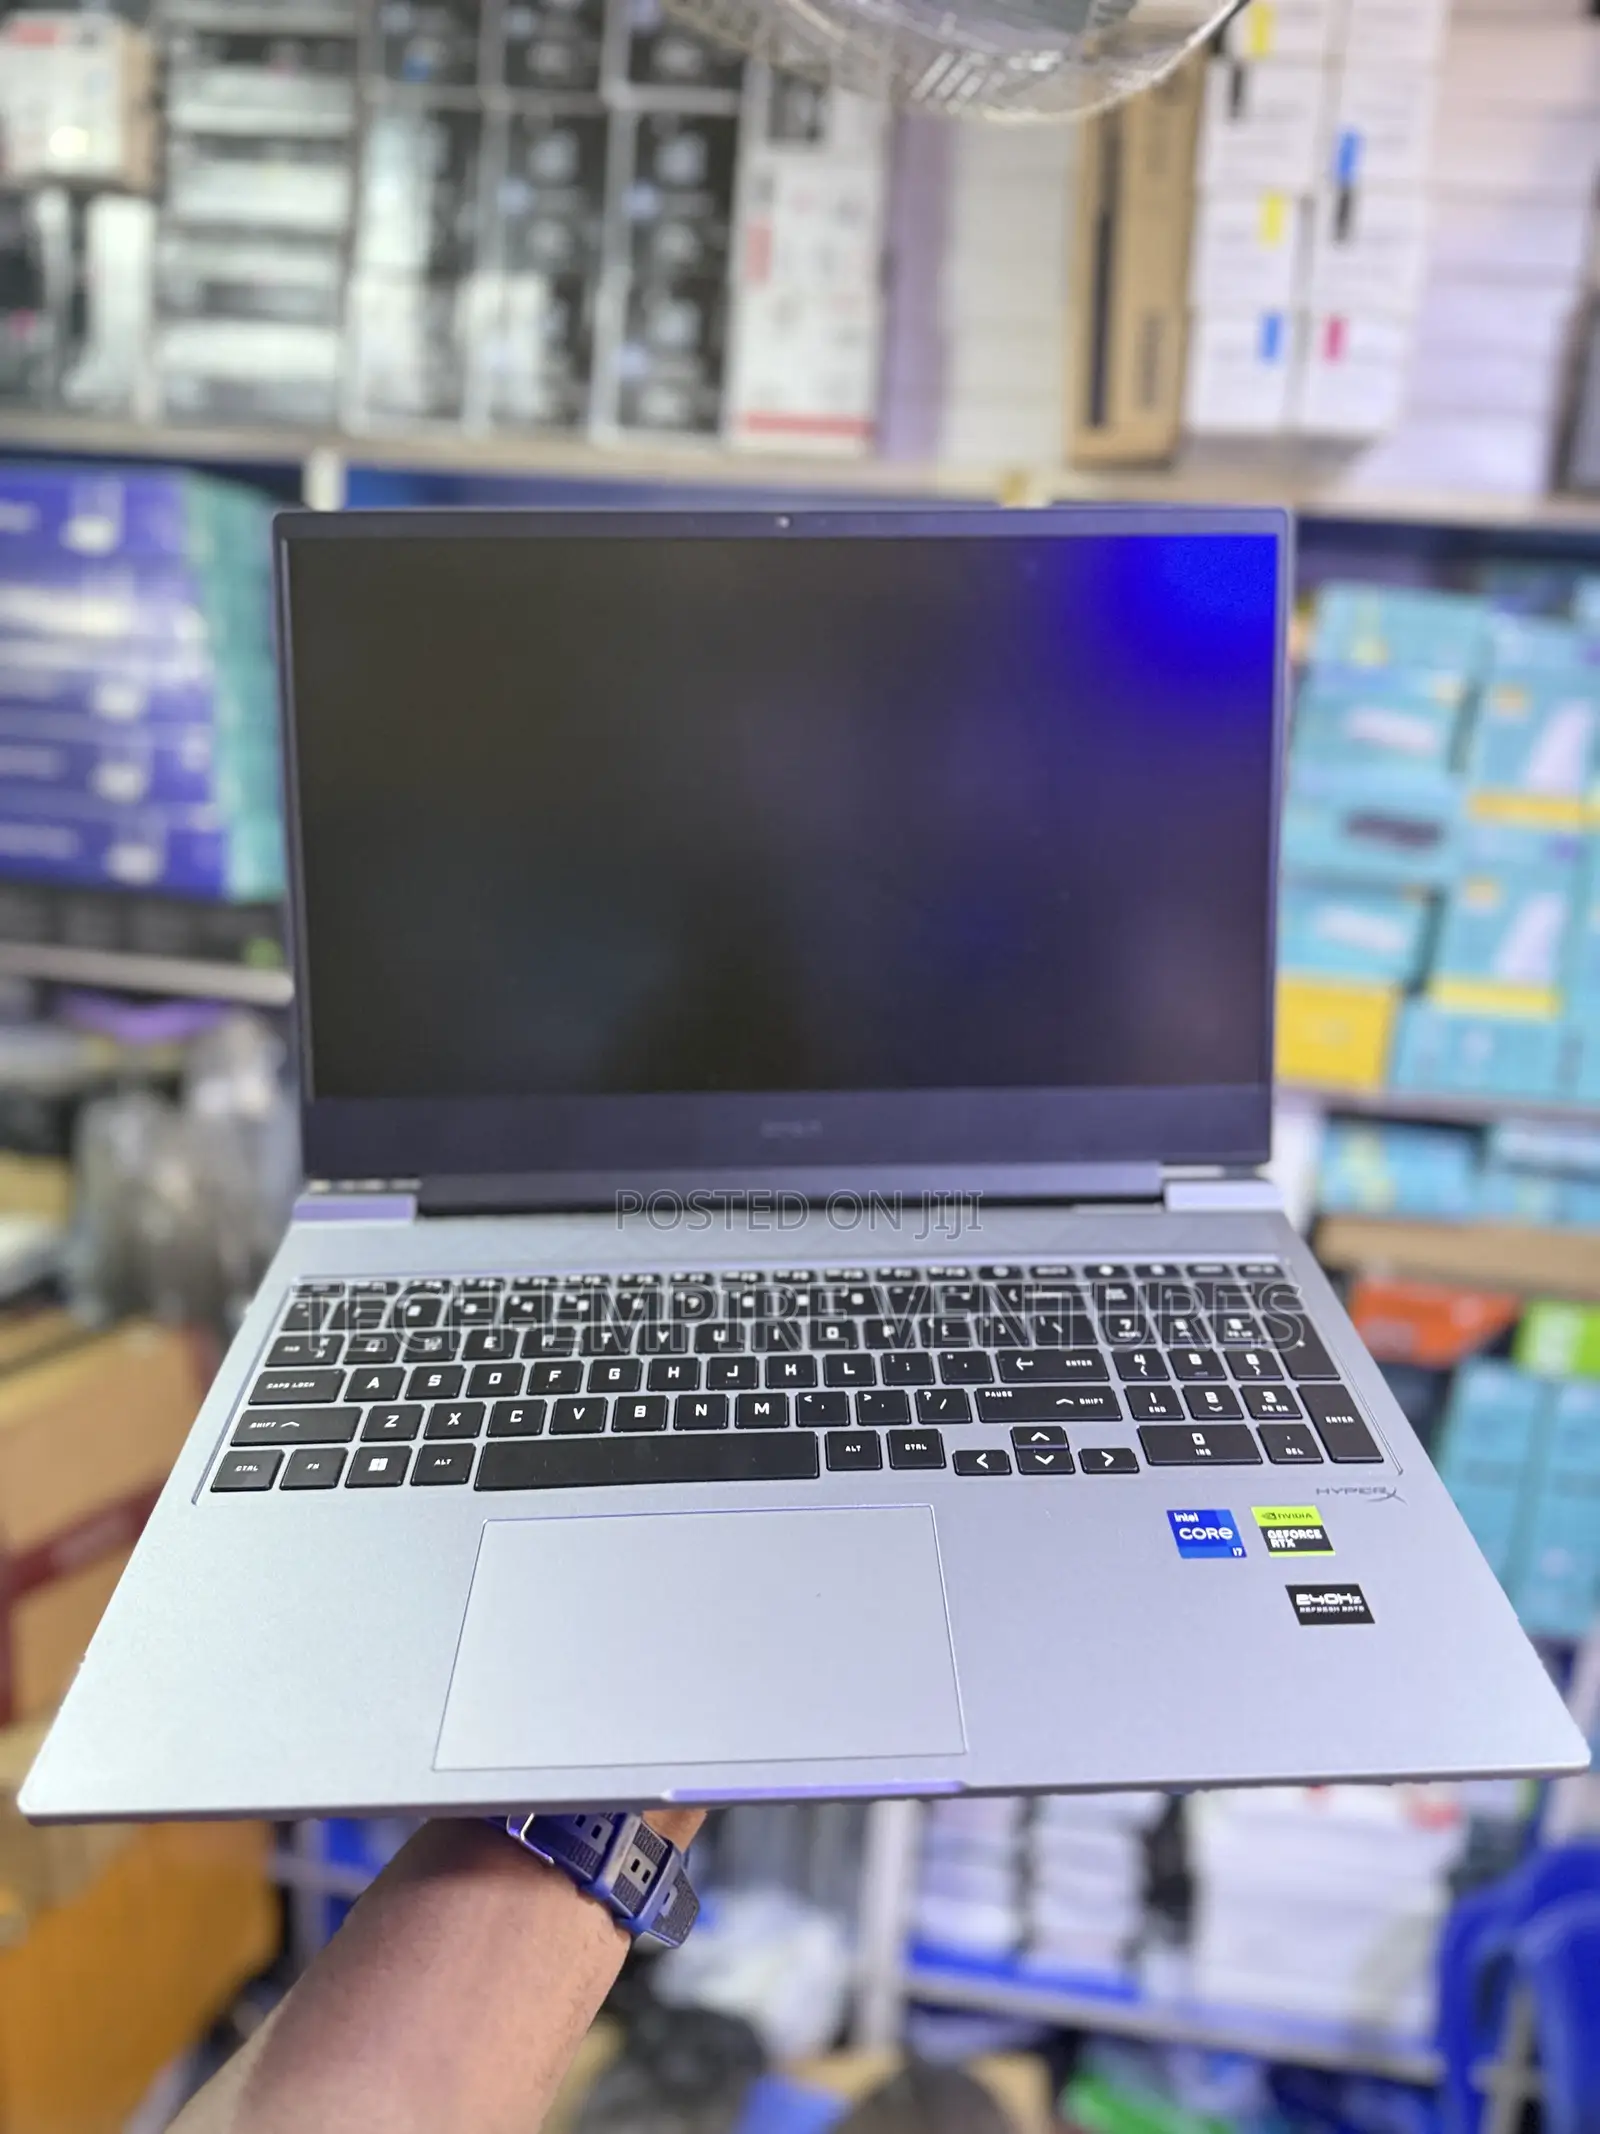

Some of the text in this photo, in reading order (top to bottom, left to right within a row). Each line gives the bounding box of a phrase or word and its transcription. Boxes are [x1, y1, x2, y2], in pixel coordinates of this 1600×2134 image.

[600, 1331, 613, 1345] T
[656, 1330, 670, 1343] Y
[713, 1329, 727, 1343] U
[826, 1326, 840, 1340] O
[483, 1335, 497, 1350] E
[1065, 1359, 1093, 1367] ENTER
[1133, 1353, 1147, 1365] 4
[608, 1367, 621, 1380] G
[667, 1366, 680, 1379] H
[726, 1364, 739, 1378] J
[784, 1363, 797, 1377] K
[843, 1362, 856, 1375] L
[366, 1376, 380, 1389] A
[427, 1374, 442, 1387] S
[488, 1372, 503, 1385] D
[548, 1369, 562, 1383] F
[984, 1390, 1013, 1398] PAUSE
[1262, 1391, 1278, 1404] 3
[1079, 1397, 1104, 1405] SHIFT
[573, 1407, 586, 1420] V
[633, 1405, 647, 1418] B
[695, 1403, 708, 1417] N
[754, 1402, 770, 1415] M
[383, 1414, 400, 1428] Z
[447, 1412, 462, 1426] X
[509, 1409, 524, 1423] C
[1325, 1415, 1354, 1424] ENTER
[249, 1421, 277, 1429] SHIFT
[845, 1444, 862, 1453] ALT
[904, 1443, 928, 1451] CTRL
[234, 1464, 259, 1472] CTRL
[433, 1458, 452, 1466] ALT
[1174, 1512, 1199, 1522] intel
[1267, 1529, 1322, 1540] GEFORCE
[1269, 1538, 1296, 1548] RTX
